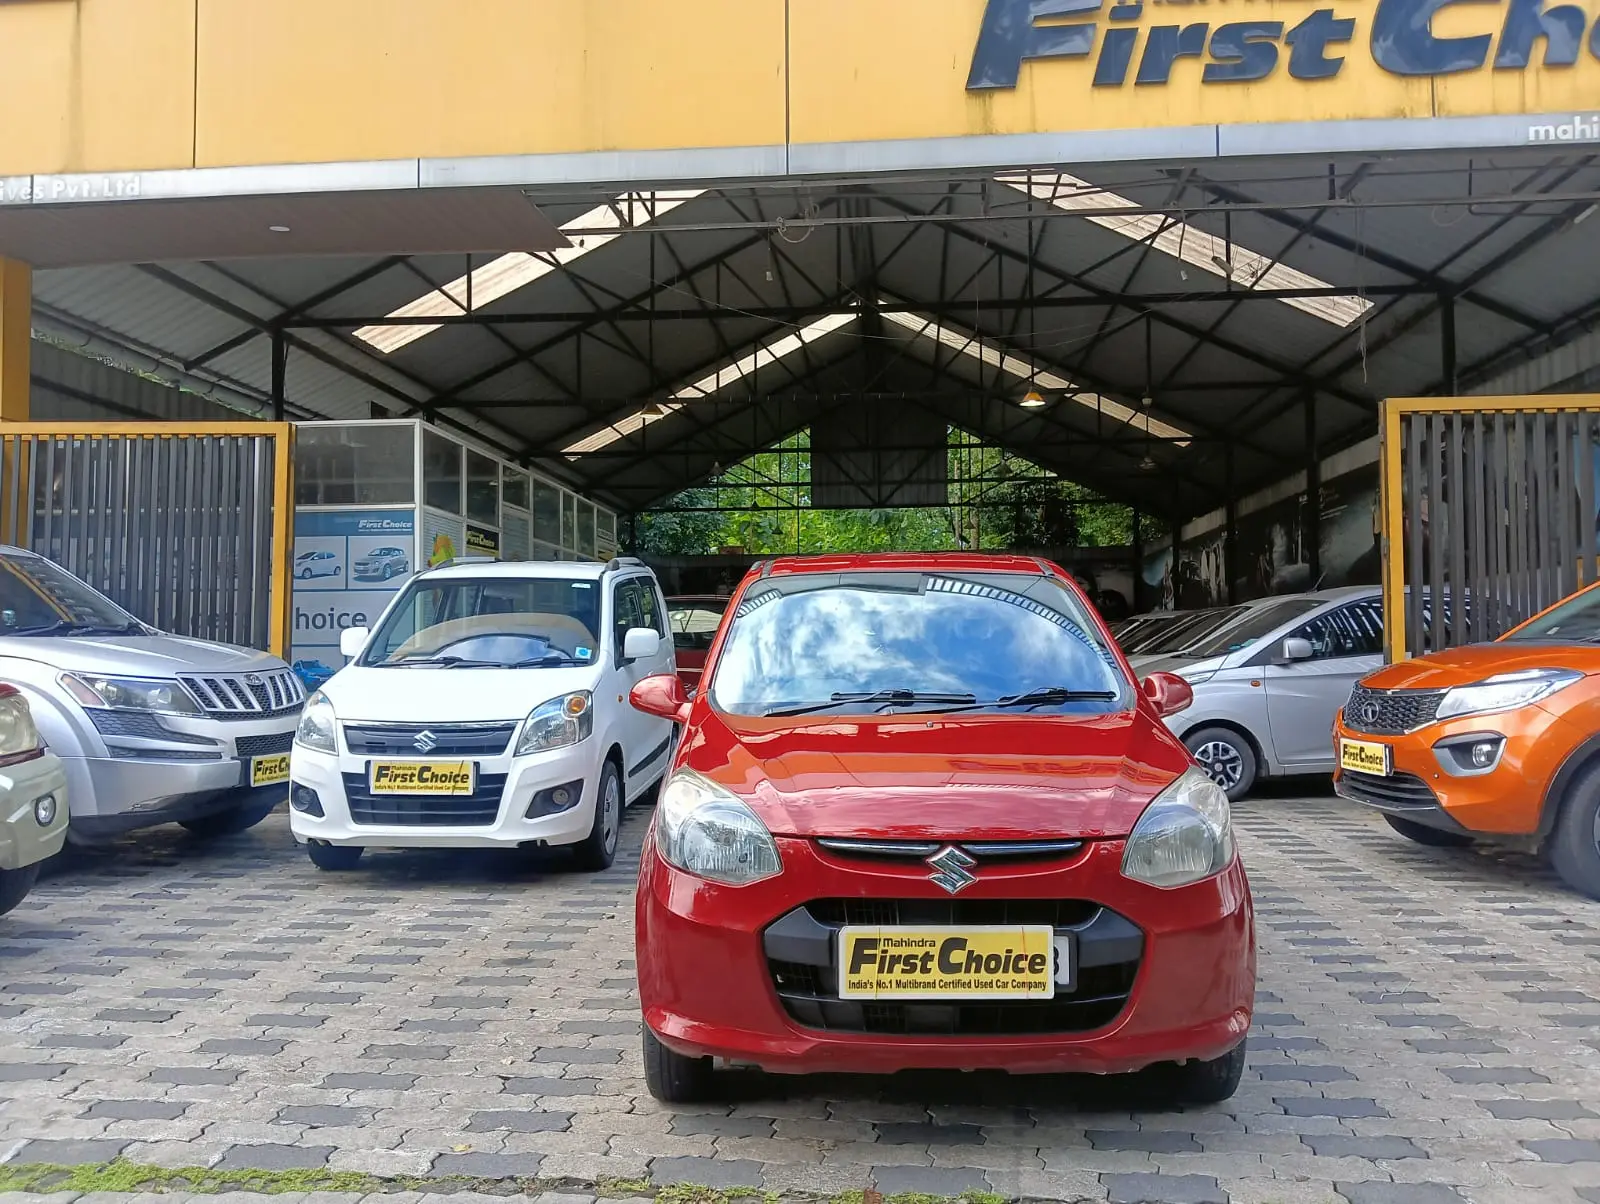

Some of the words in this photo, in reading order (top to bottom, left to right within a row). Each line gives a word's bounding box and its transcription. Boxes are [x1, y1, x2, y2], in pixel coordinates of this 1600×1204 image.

[966, 0, 1356, 90] First
[1370, 0, 1600, 76] Ch
[103, 175, 140, 197] Ltd
[1342, 743, 1360, 762] First
[1359, 745, 1384, 766] Choice
[254, 760, 278, 777] First
[375, 765, 416, 783] First
[417, 765, 470, 784] Choice
[882, 937, 936, 948] Mahindra
[848, 937, 935, 975] First
[937, 936, 1047, 975] Choice
[848, 979, 874, 990] India's
[895, 978, 937, 989] Multibrand
[938, 978, 972, 989] Certified
[973, 978, 993, 989] Used
[995, 978, 1009, 989] Car
[1010, 978, 1047, 992] Company
